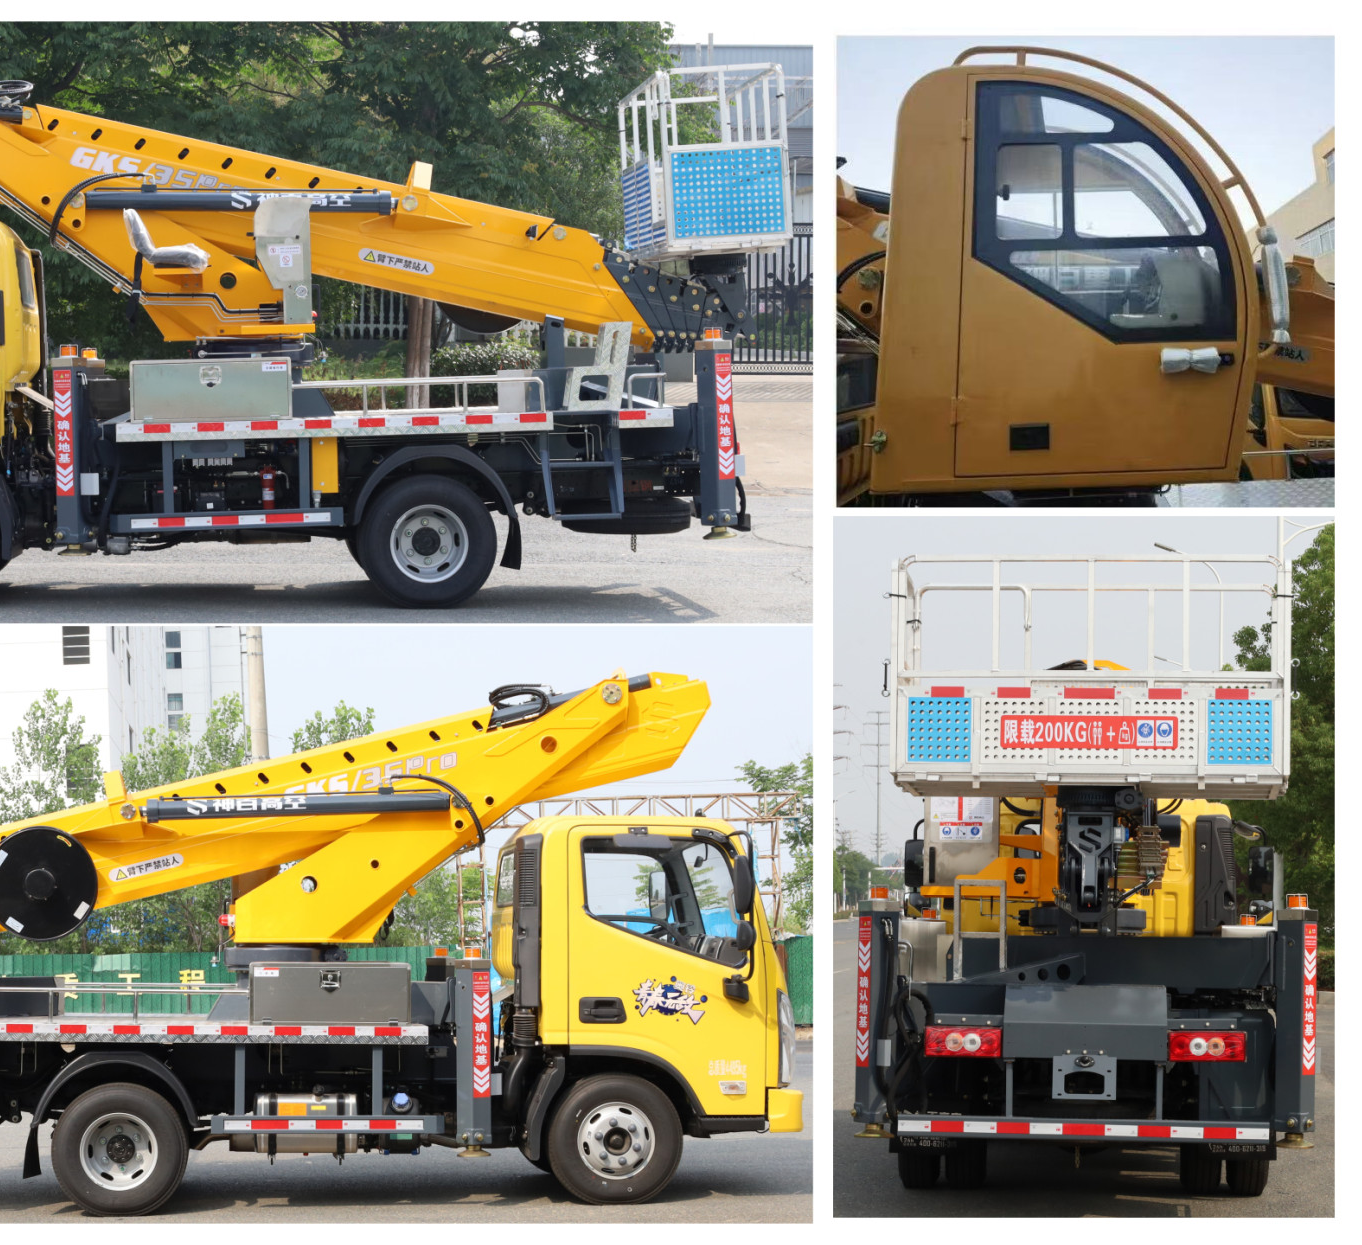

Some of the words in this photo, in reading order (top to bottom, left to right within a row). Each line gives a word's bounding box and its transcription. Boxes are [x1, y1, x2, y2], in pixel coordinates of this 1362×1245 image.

[377, 253, 430, 274] 臂下严禁站人
[56, 419, 71, 464] 确认地基
[718, 403, 732, 448] 确认地基
[126, 855, 180, 877] 臂下严禁站人
[858, 976, 869, 1028] 确认地基
[1304, 984, 1315, 1036] 确认地基
[474, 1022, 488, 1066] 确认地基
